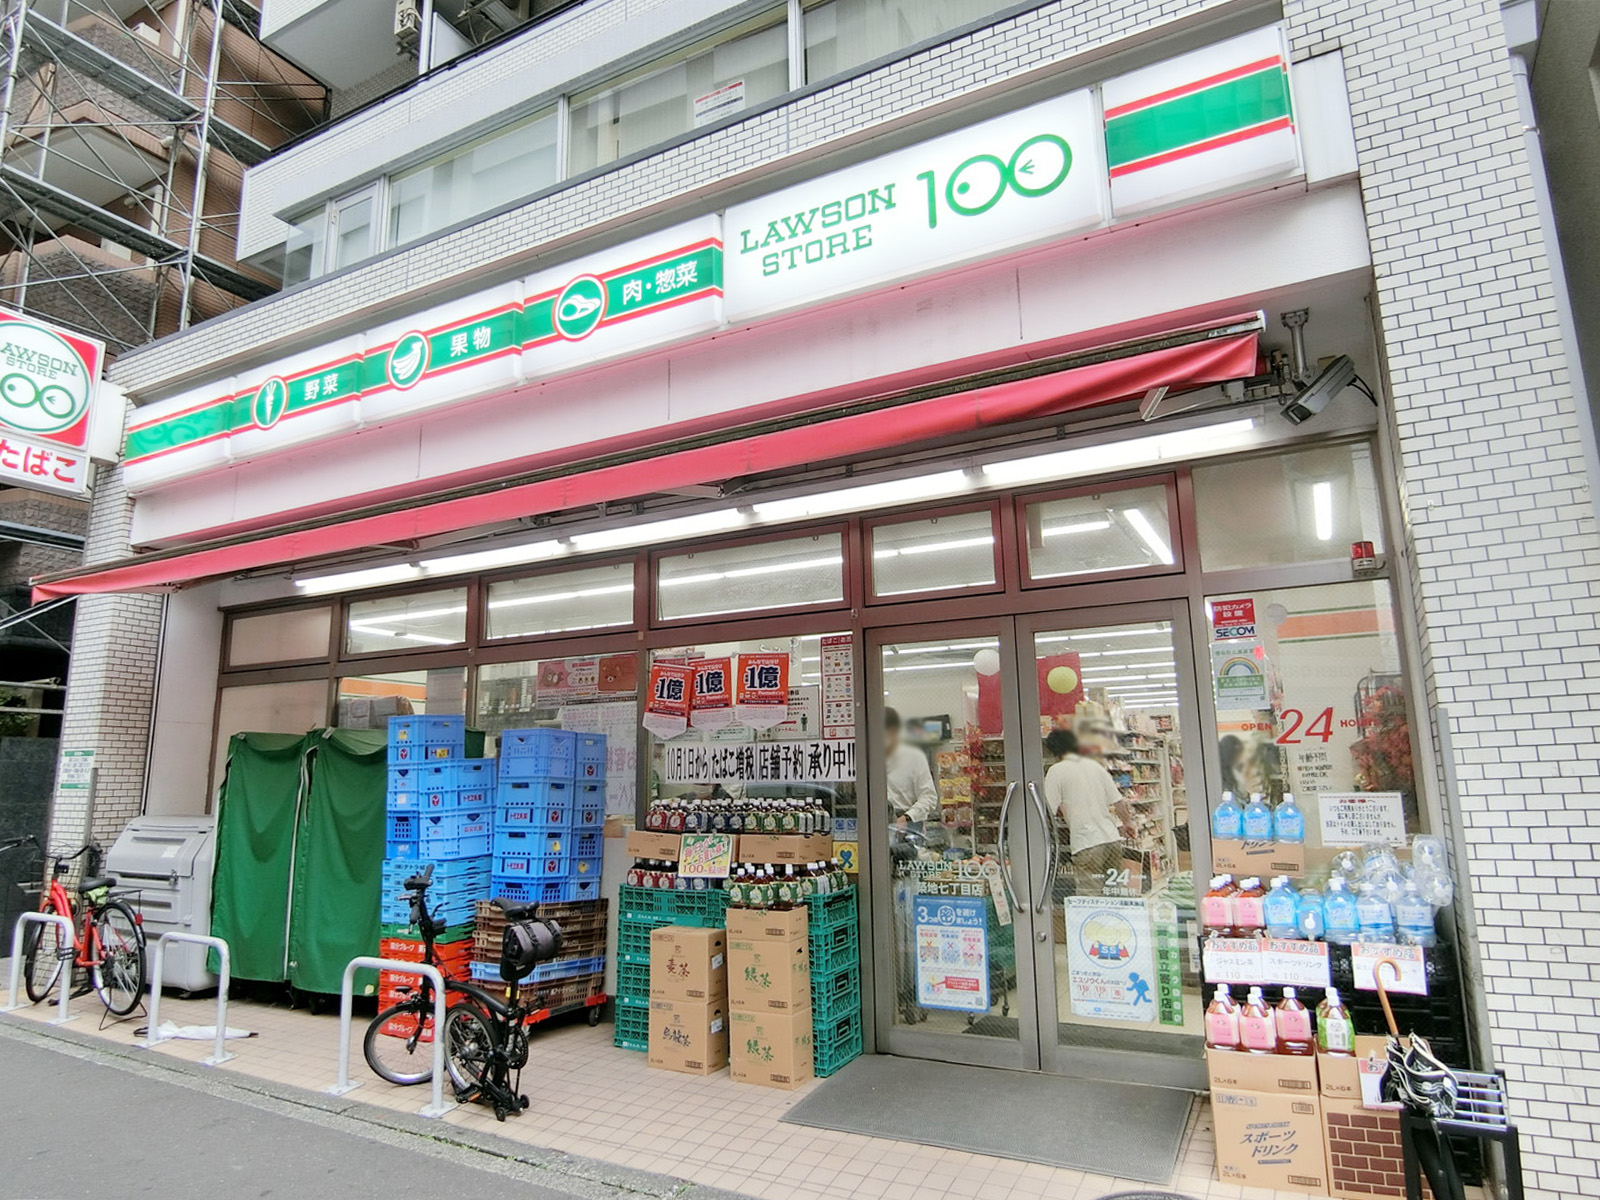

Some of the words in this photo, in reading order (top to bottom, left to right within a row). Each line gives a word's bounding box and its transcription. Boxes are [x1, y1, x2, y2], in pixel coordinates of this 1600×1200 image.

[916, 133, 1073, 229] 100
[739, 183, 897, 254] LAWSON
[762, 224, 874, 277] STORE
[622, 260, 699, 305] 肉・惣菜
[450, 326, 491, 358] 果物
[0, 342, 78, 377] AWSON
[5, 356, 58, 380] STORE
[303, 373, 339, 401] 野菜
[0, 438, 77, 484] たばこ
[1215, 625, 1255, 638] SECOM
[1241, 722, 1273, 731] OPEN
[1275, 707, 1334, 745] 24
[898, 859, 952, 870] LAWSON
[1105, 867, 1130, 887] 24
[1211, 940, 1258, 951] おすすめ品
[1268, 940, 1320, 954] おすすめ品
[666, 957, 691, 978] 麦茶
[744, 966, 772, 988] 緑茶
[746, 1039, 774, 1062] 緑茶
[1239, 1130, 1297, 1145] スポーツ
[1251, 1143, 1299, 1158] ドリンク
